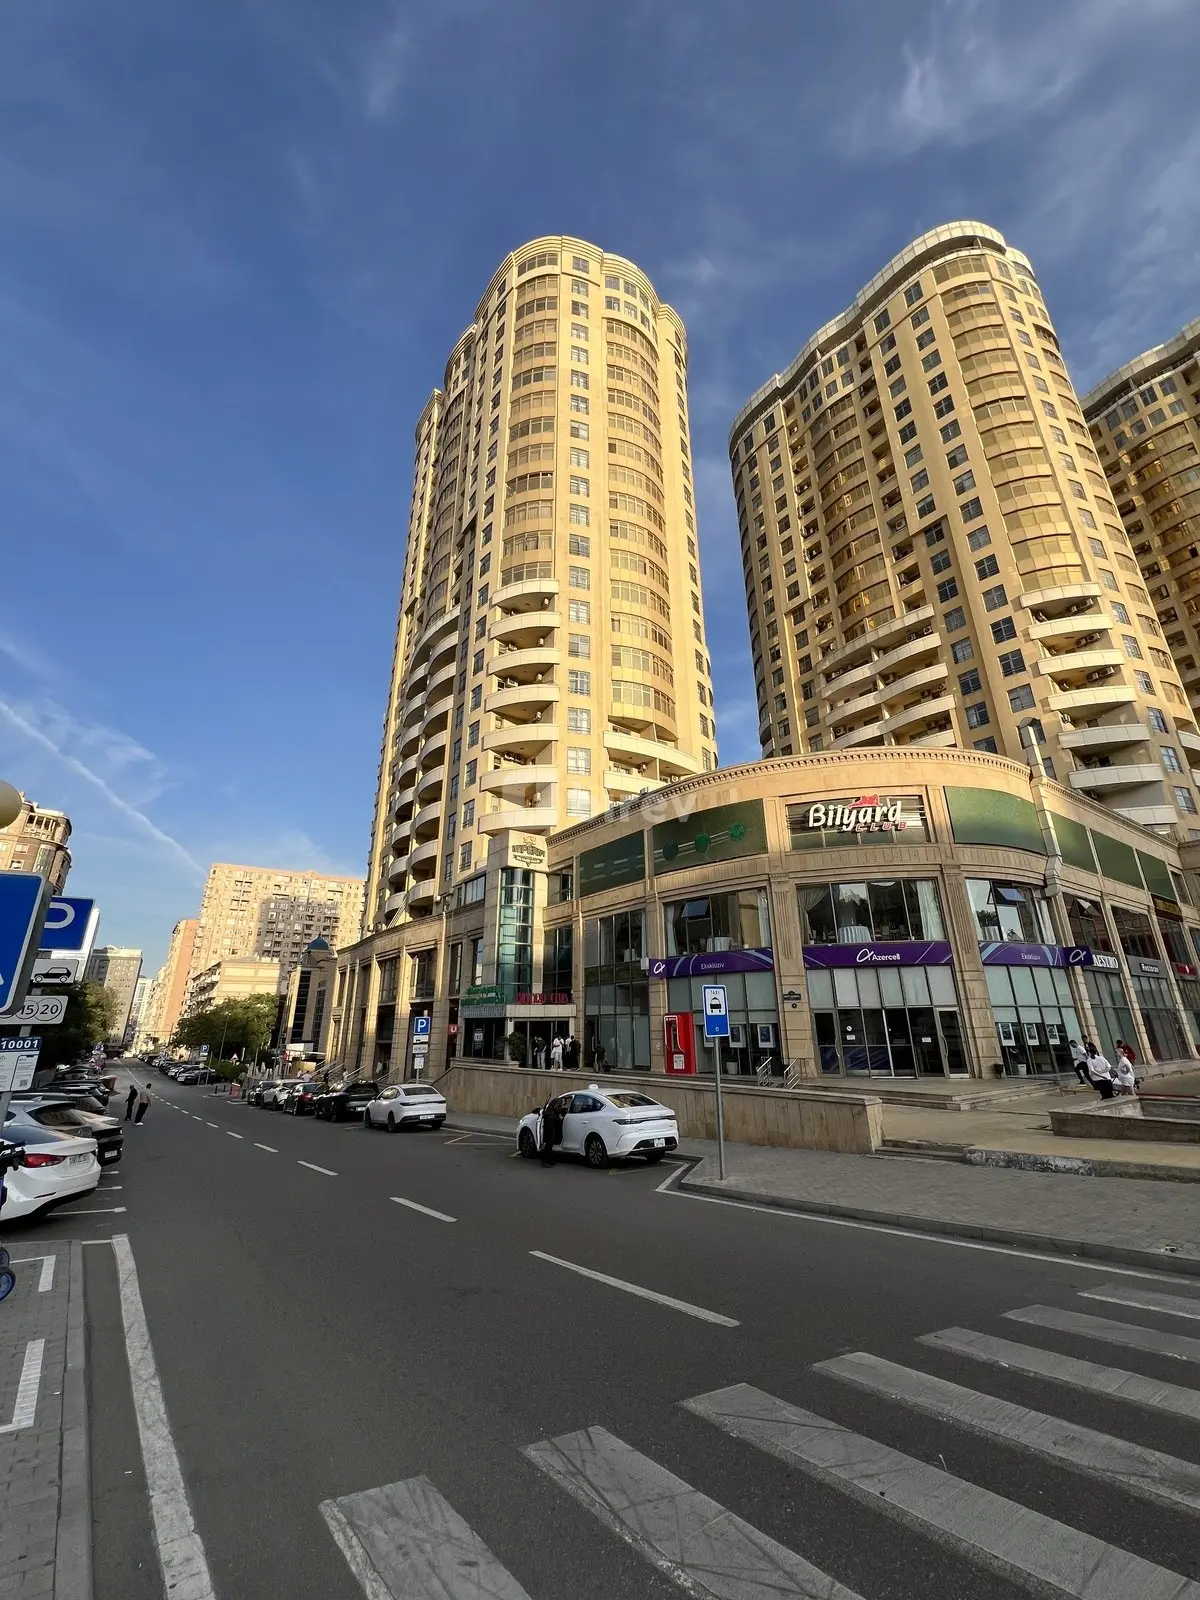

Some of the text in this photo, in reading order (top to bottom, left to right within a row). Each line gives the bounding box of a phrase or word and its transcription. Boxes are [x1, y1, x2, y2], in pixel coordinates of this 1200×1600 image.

[809, 801, 902, 832] Bilyard
[855, 821, 907, 832] CLUB
[872, 953, 901, 961] Azercell
[40, 1004, 59, 1014] 20
[418, 1018, 427, 1032] P
[1, 1039, 39, 1050] 10001
